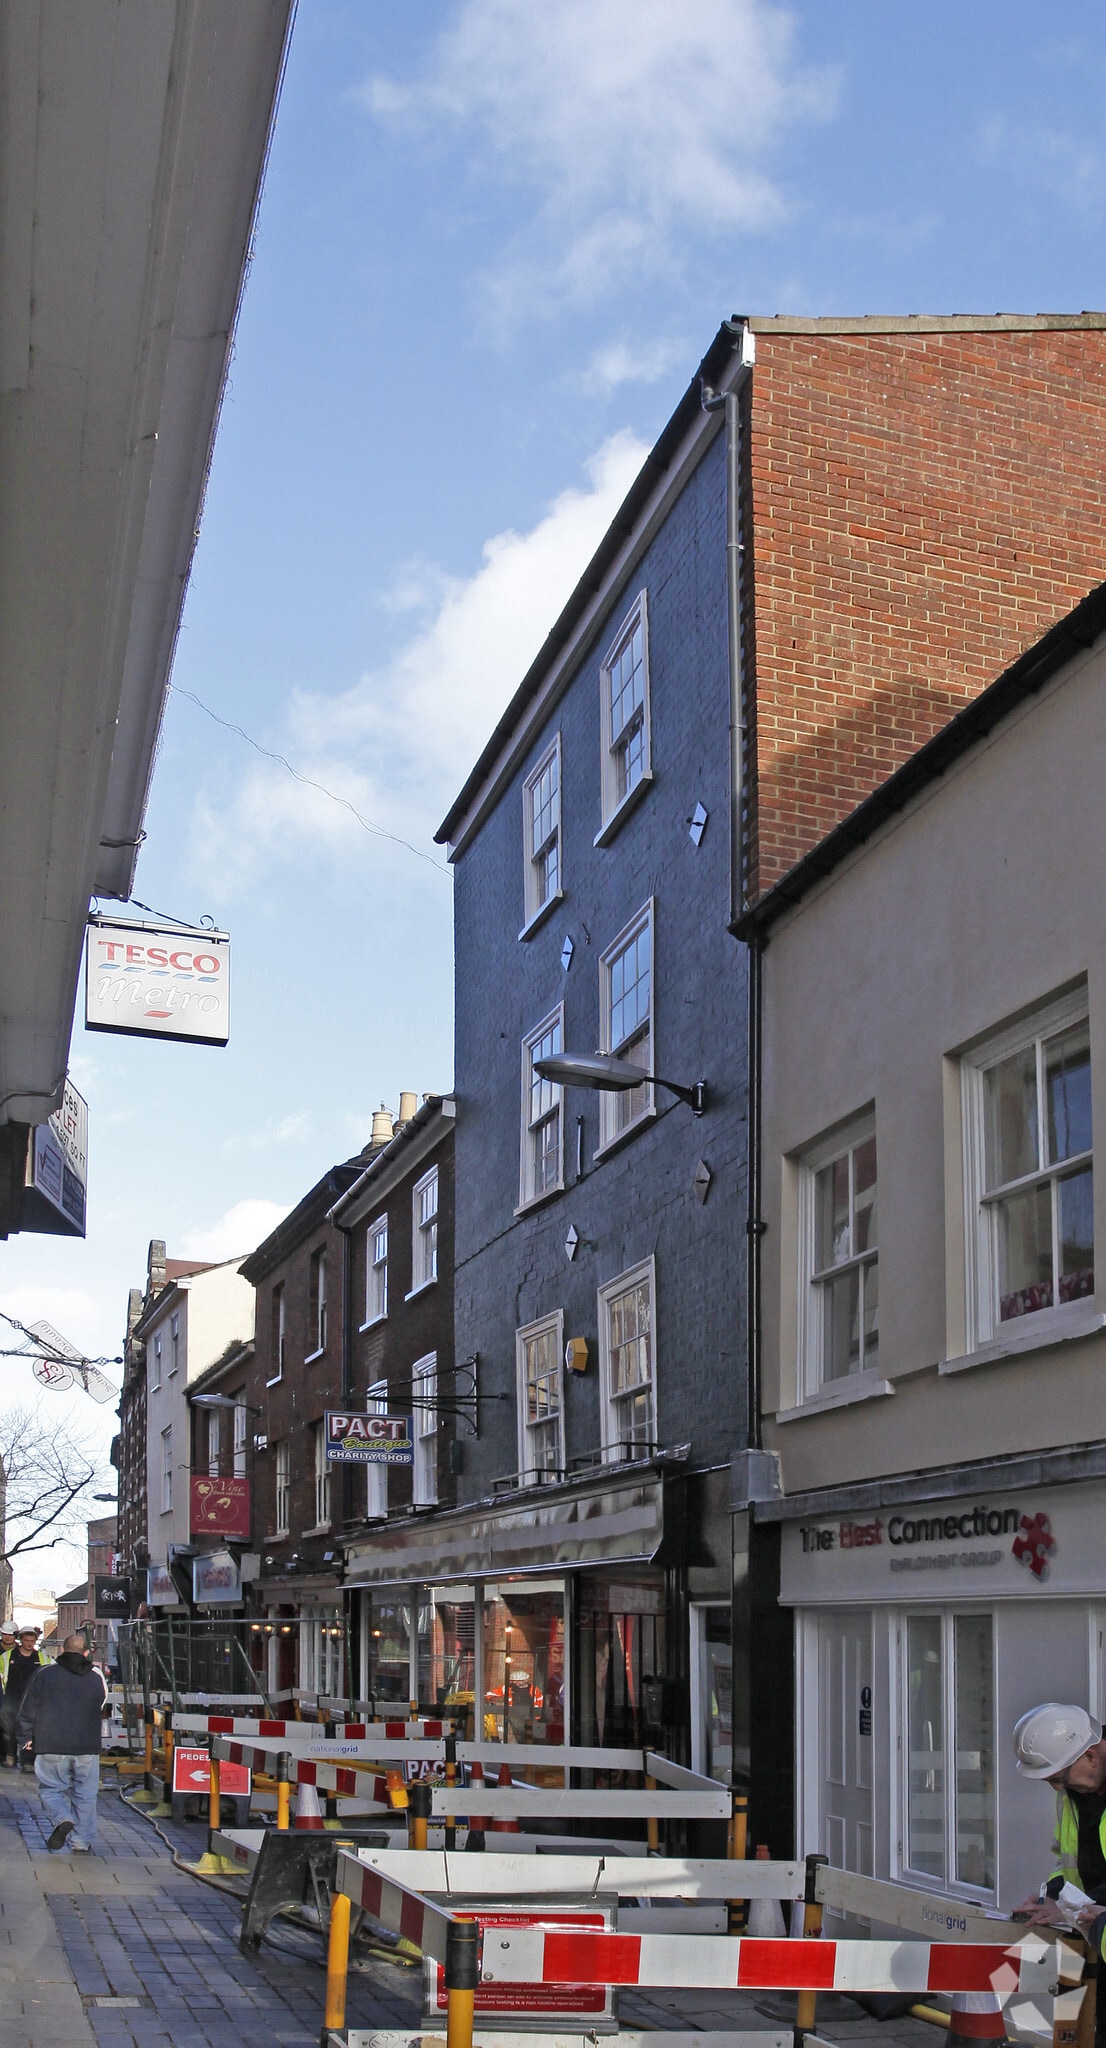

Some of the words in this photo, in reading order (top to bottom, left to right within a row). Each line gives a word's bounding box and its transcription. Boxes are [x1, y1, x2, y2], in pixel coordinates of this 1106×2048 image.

[98, 941, 220, 975] TESCO
[63, 1110, 77, 1138] LET
[331, 1416, 404, 1439] PACT
[342, 1438, 412, 1451] Boutique
[328, 1450, 378, 1461] CHARITY
[379, 1453, 411, 1462] SHOP
[800, 1527, 835, 1552] The
[839, 1518, 883, 1549] Best
[888, 1506, 1019, 1545] Connection
[960, 1550, 1003, 1567] GROUP
[407, 1761, 446, 1779] PAC
